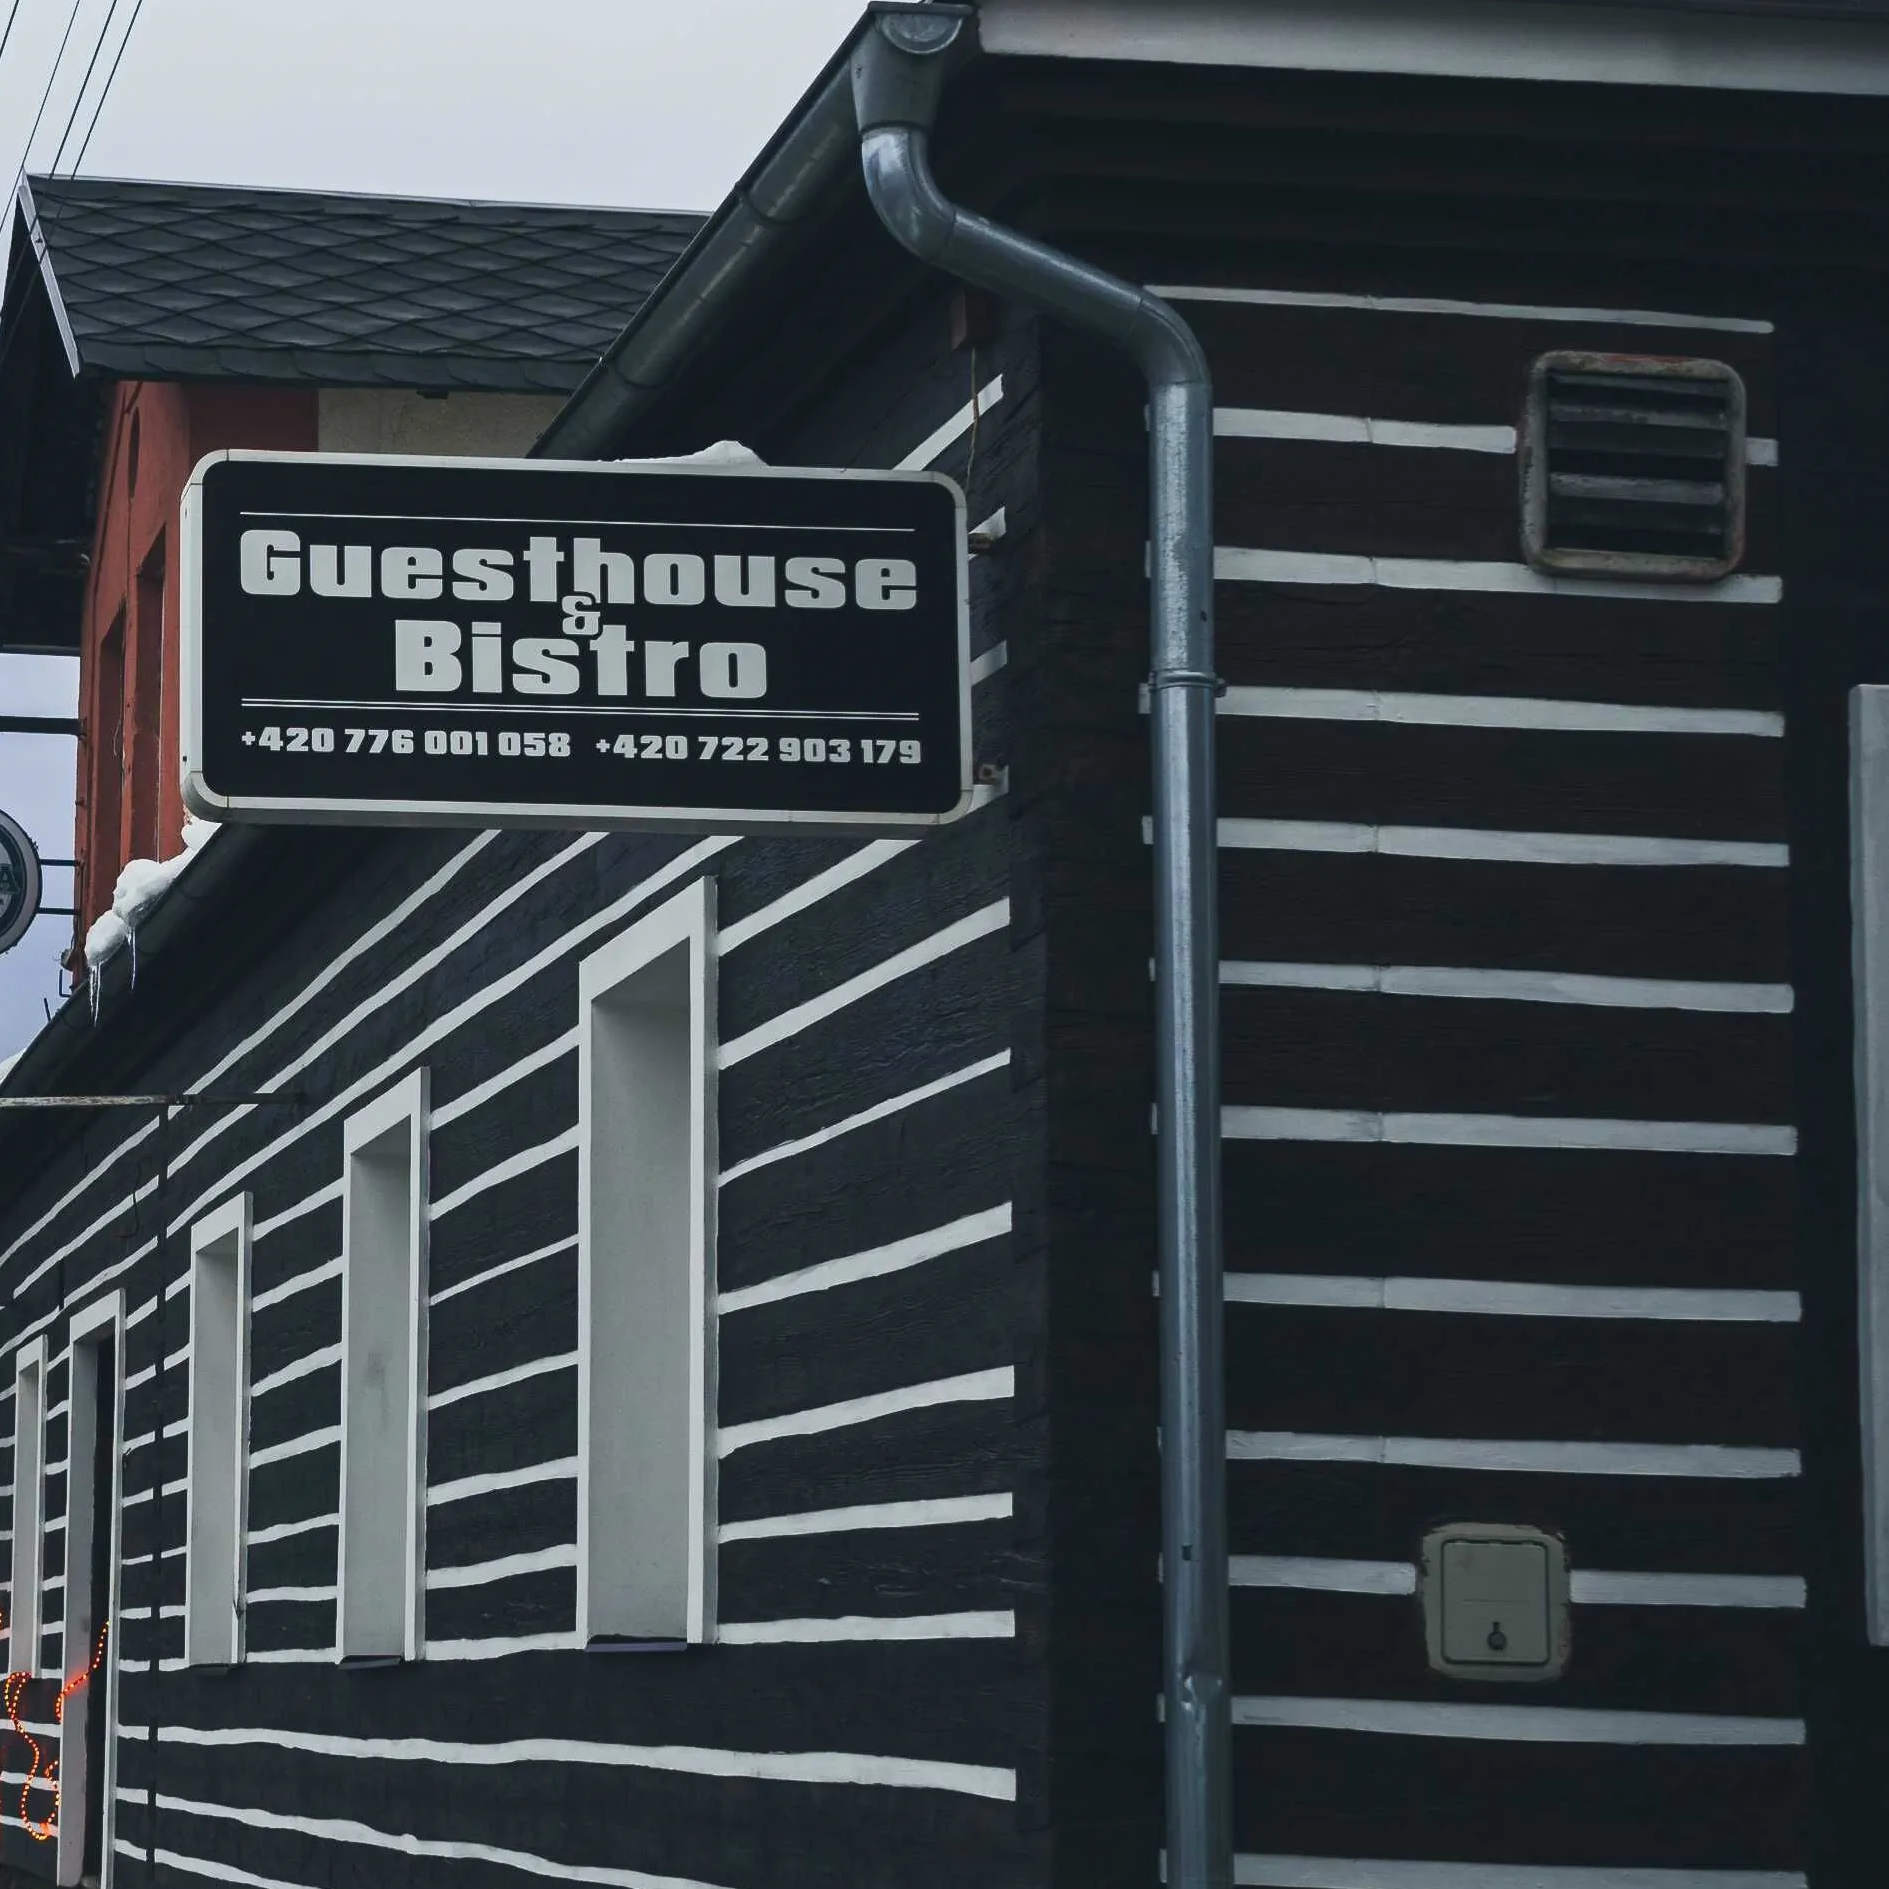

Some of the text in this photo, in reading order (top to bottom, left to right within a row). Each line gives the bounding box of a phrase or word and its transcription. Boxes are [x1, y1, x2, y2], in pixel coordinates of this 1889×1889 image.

[240, 529, 917, 610] Guesthouse
[562, 595, 601, 636] &
[394, 619, 767, 699] Bistro
[241, 726, 922, 764] +420 776 001 058 +420 722 903 179
